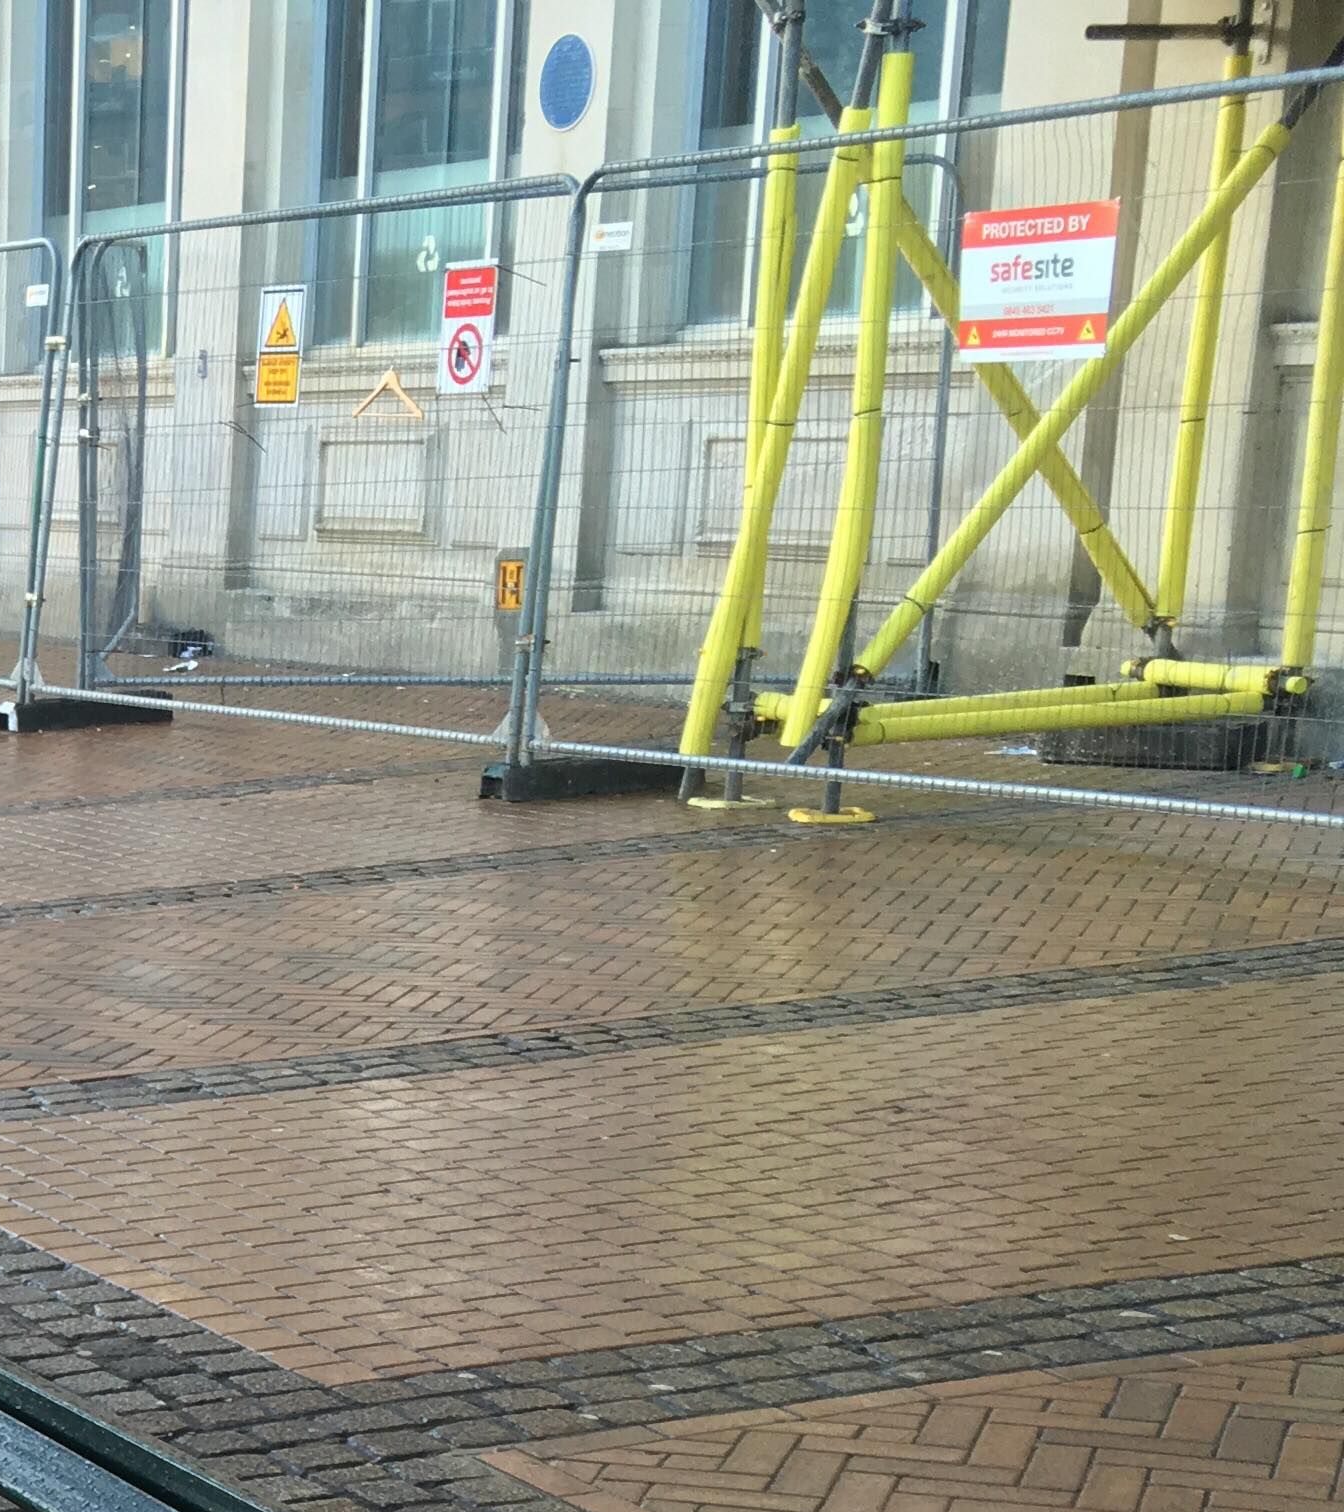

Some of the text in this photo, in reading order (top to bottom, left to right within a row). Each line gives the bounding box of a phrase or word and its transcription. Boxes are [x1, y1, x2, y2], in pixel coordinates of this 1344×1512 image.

[981, 213, 1091, 241] PROTECTED BY
[990, 252, 1075, 283] safesite
